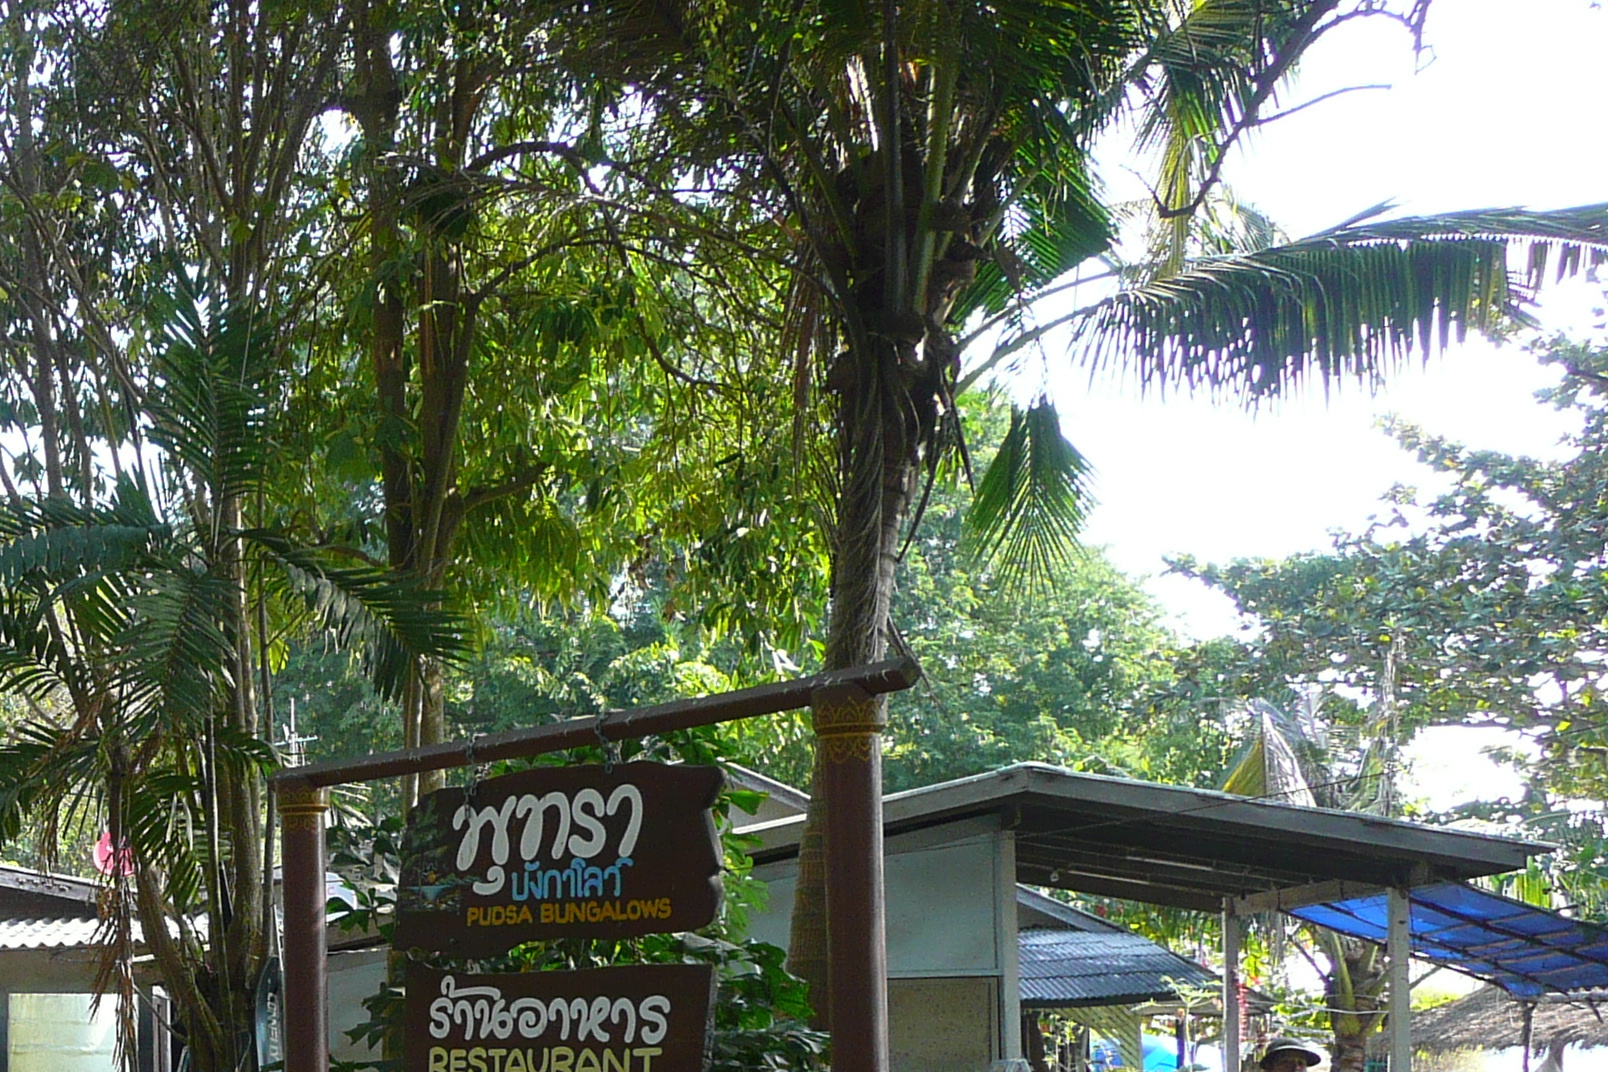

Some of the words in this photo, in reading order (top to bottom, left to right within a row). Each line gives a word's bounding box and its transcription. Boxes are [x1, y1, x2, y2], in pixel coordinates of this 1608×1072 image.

[452, 783, 643, 896] พุทรา
[511, 856, 633, 901] บังกาโลว์
[466, 905, 533, 927] PUDSA
[540, 897, 673, 925] BUNGALOWS
[428, 975, 671, 1045] ร้านอาหาร
